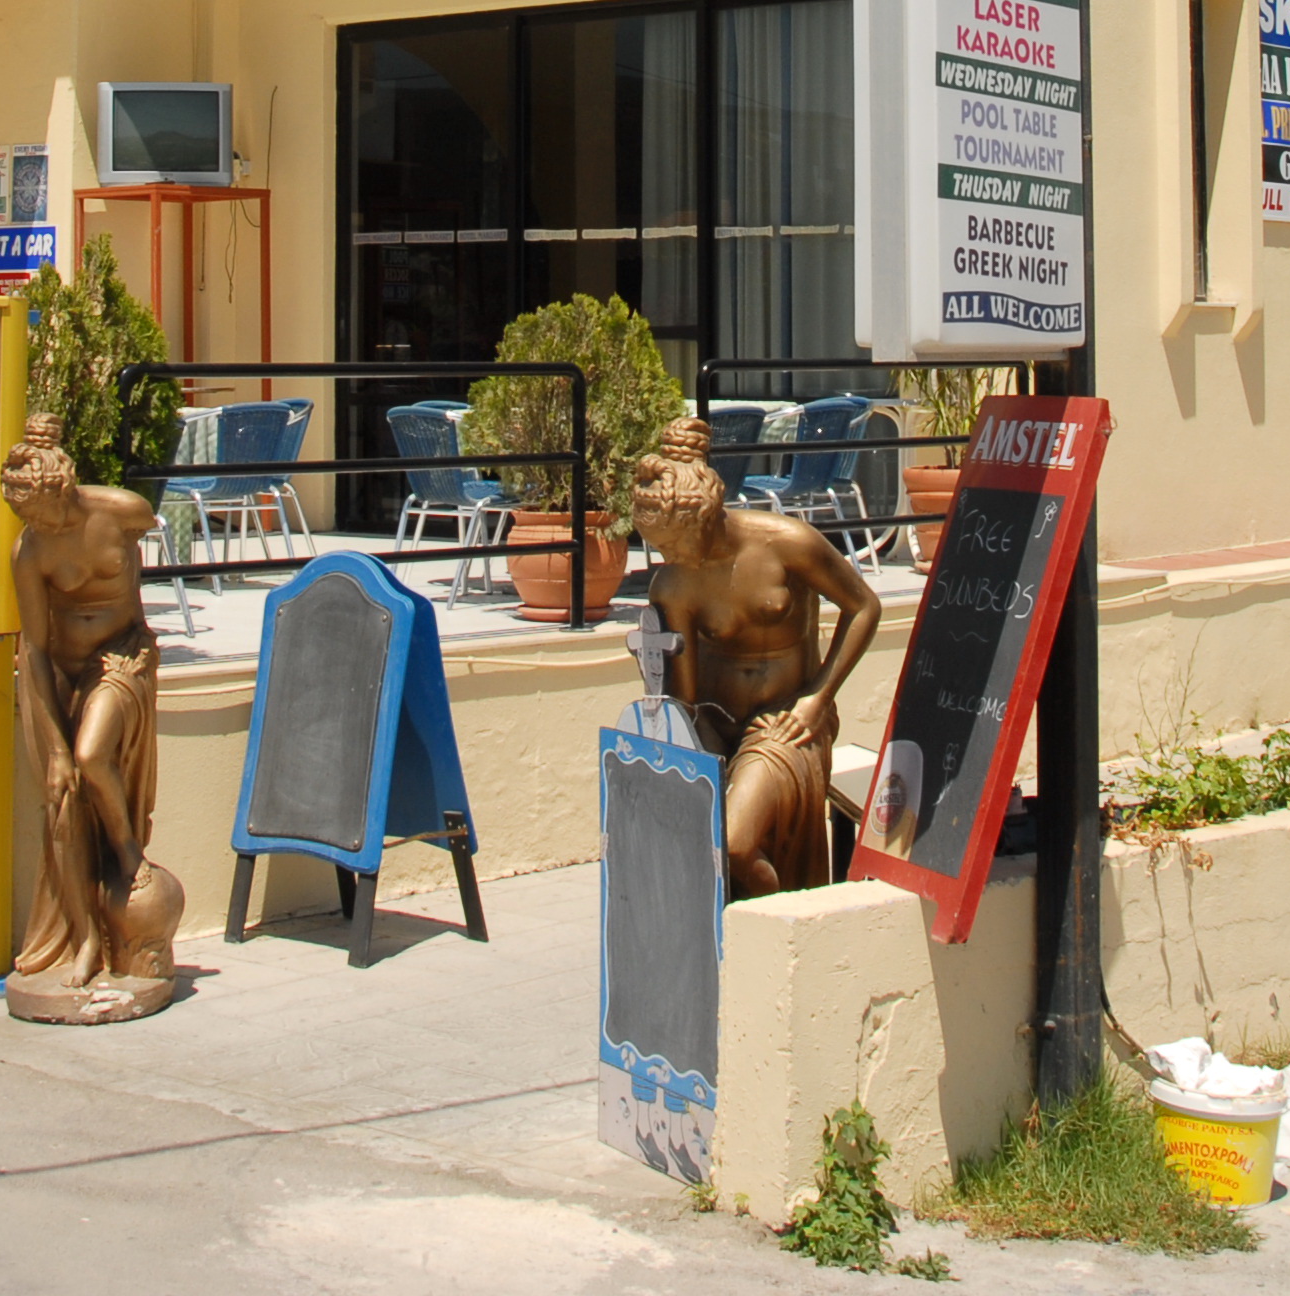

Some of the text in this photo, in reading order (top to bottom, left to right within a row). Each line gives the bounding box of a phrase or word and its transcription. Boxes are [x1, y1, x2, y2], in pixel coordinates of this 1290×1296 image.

[956, 25, 1055, 69] KARAOKE
[940, 60, 1077, 108] WEDNESDAY NIGHT
[1261, 52, 1282, 96] AA
[961, 99, 1057, 139] POOL TABLE
[954, 134, 1065, 174] TOURNAMENT
[953, 173, 1071, 210] THUSDAY NIGHT
[11, 234, 22, 256] A
[25, 233, 54, 257] CAR
[967, 214, 1055, 251] BARBECUE
[953, 246, 1068, 286] GREEK NIGHT
[945, 295, 1080, 330] ALL WELCOME
[970, 415, 1081, 470] AMSTEL
[956, 509, 1012, 554] FREE
[931, 572, 1035, 619] SUNBEDS
[916, 650, 935, 679] ALL
[937, 686, 1006, 722] WELCOME
[1201, 1124, 1236, 1135] PAINT
